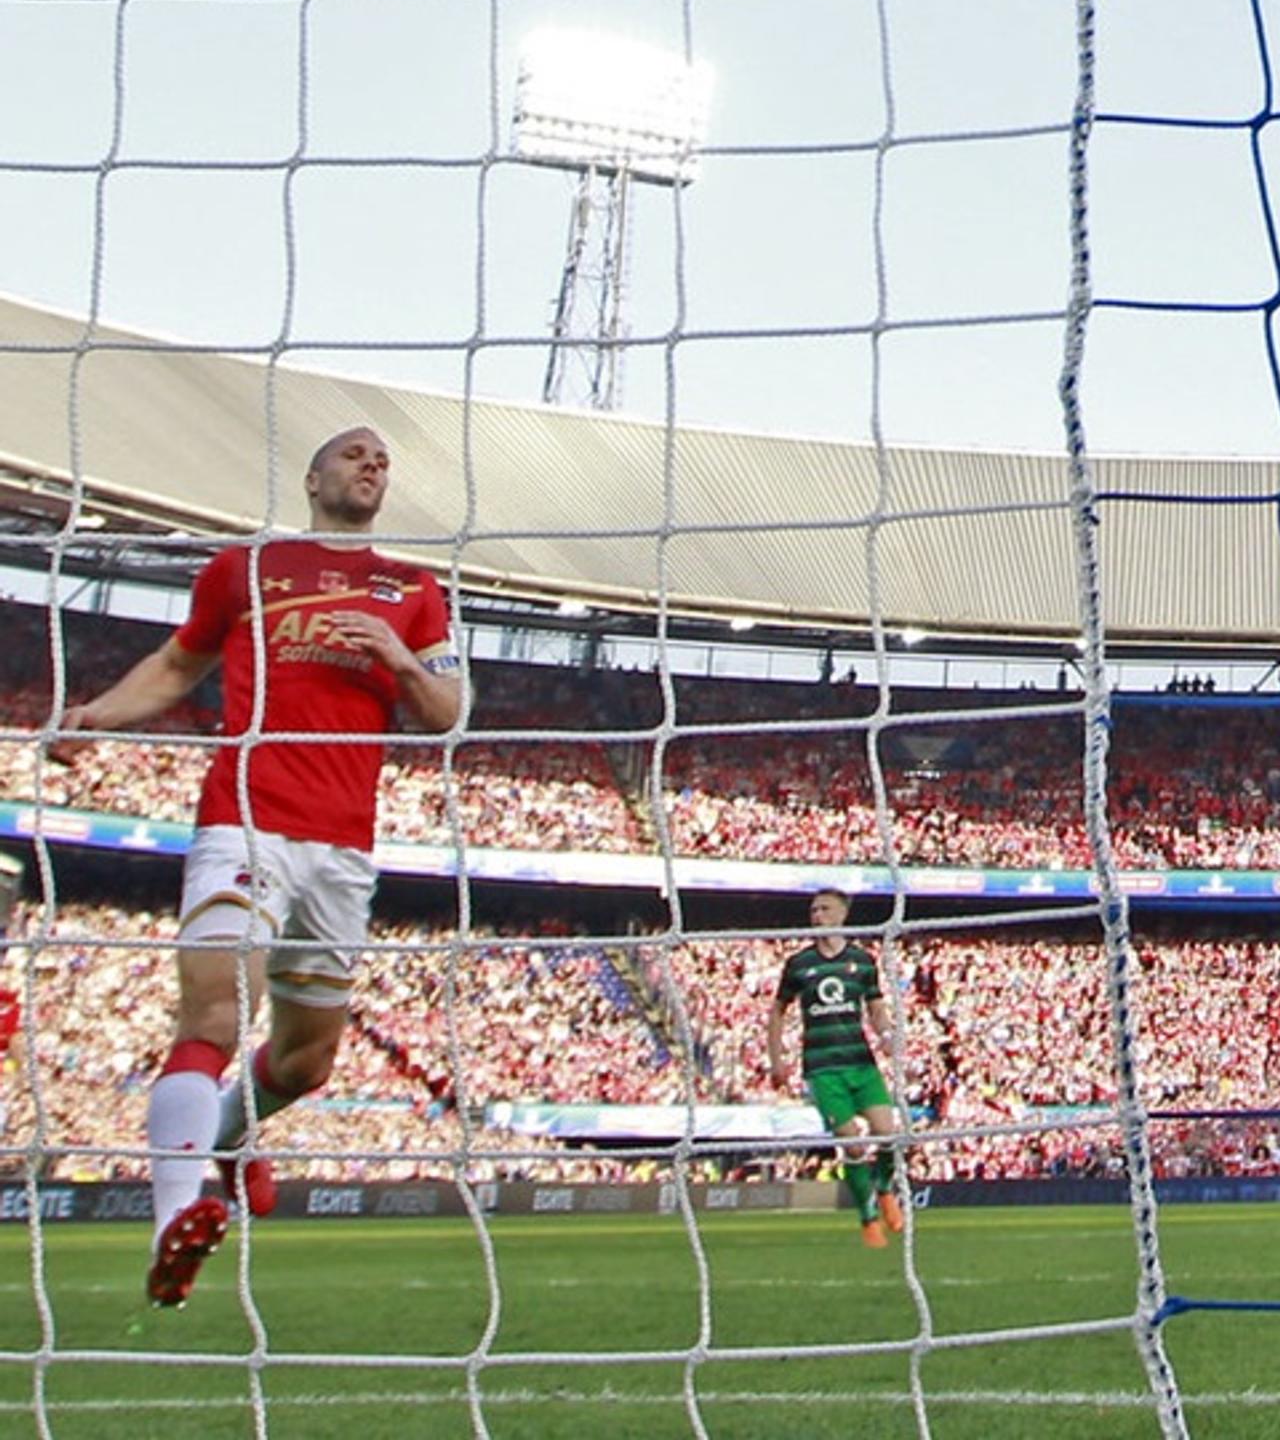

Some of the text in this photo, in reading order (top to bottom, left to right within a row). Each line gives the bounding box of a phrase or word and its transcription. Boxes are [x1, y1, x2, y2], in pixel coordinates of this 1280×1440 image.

[269, 610, 362, 651] AFA
[818, 976, 845, 1005] Q
[0, 1189, 73, 1218] ECTE
